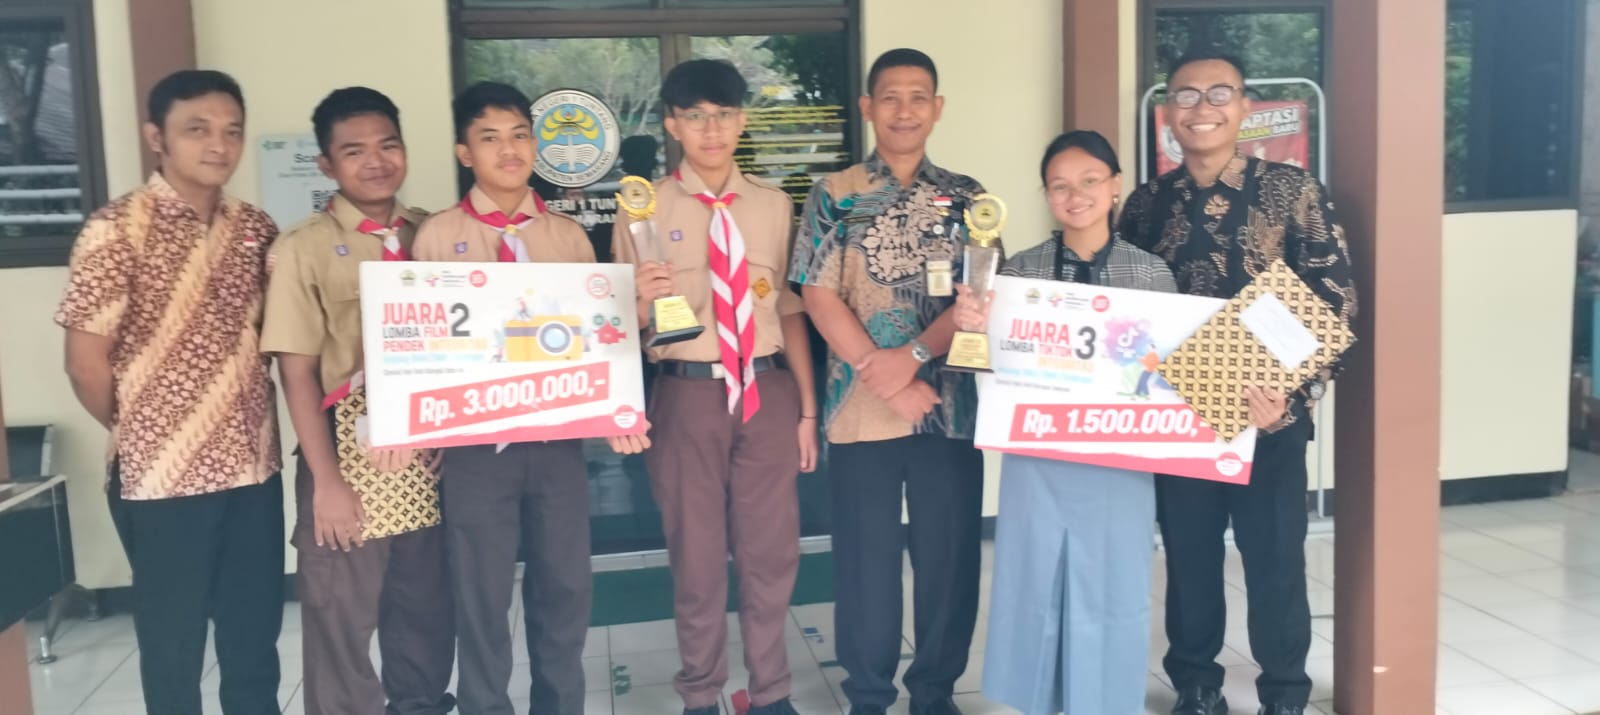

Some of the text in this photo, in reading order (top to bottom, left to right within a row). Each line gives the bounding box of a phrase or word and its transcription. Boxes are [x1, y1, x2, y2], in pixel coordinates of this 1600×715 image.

[1239, 107, 1299, 130] APTASI
[294, 153, 318, 163] Sca
[544, 198, 617, 211] GERI 1 TUN
[382, 302, 472, 337] JUARA 2
[383, 325, 448, 338] LOMBA FILM
[1009, 318, 1096, 360] JUARA 3
[383, 340, 424, 352] PENDEK
[1000, 339, 1034, 353] LOMBA
[1038, 343, 1072, 357] TIKTOK
[419, 370, 606, 426] Rp. 3.000.000,-
[1022, 409, 1057, 438] Rp.
